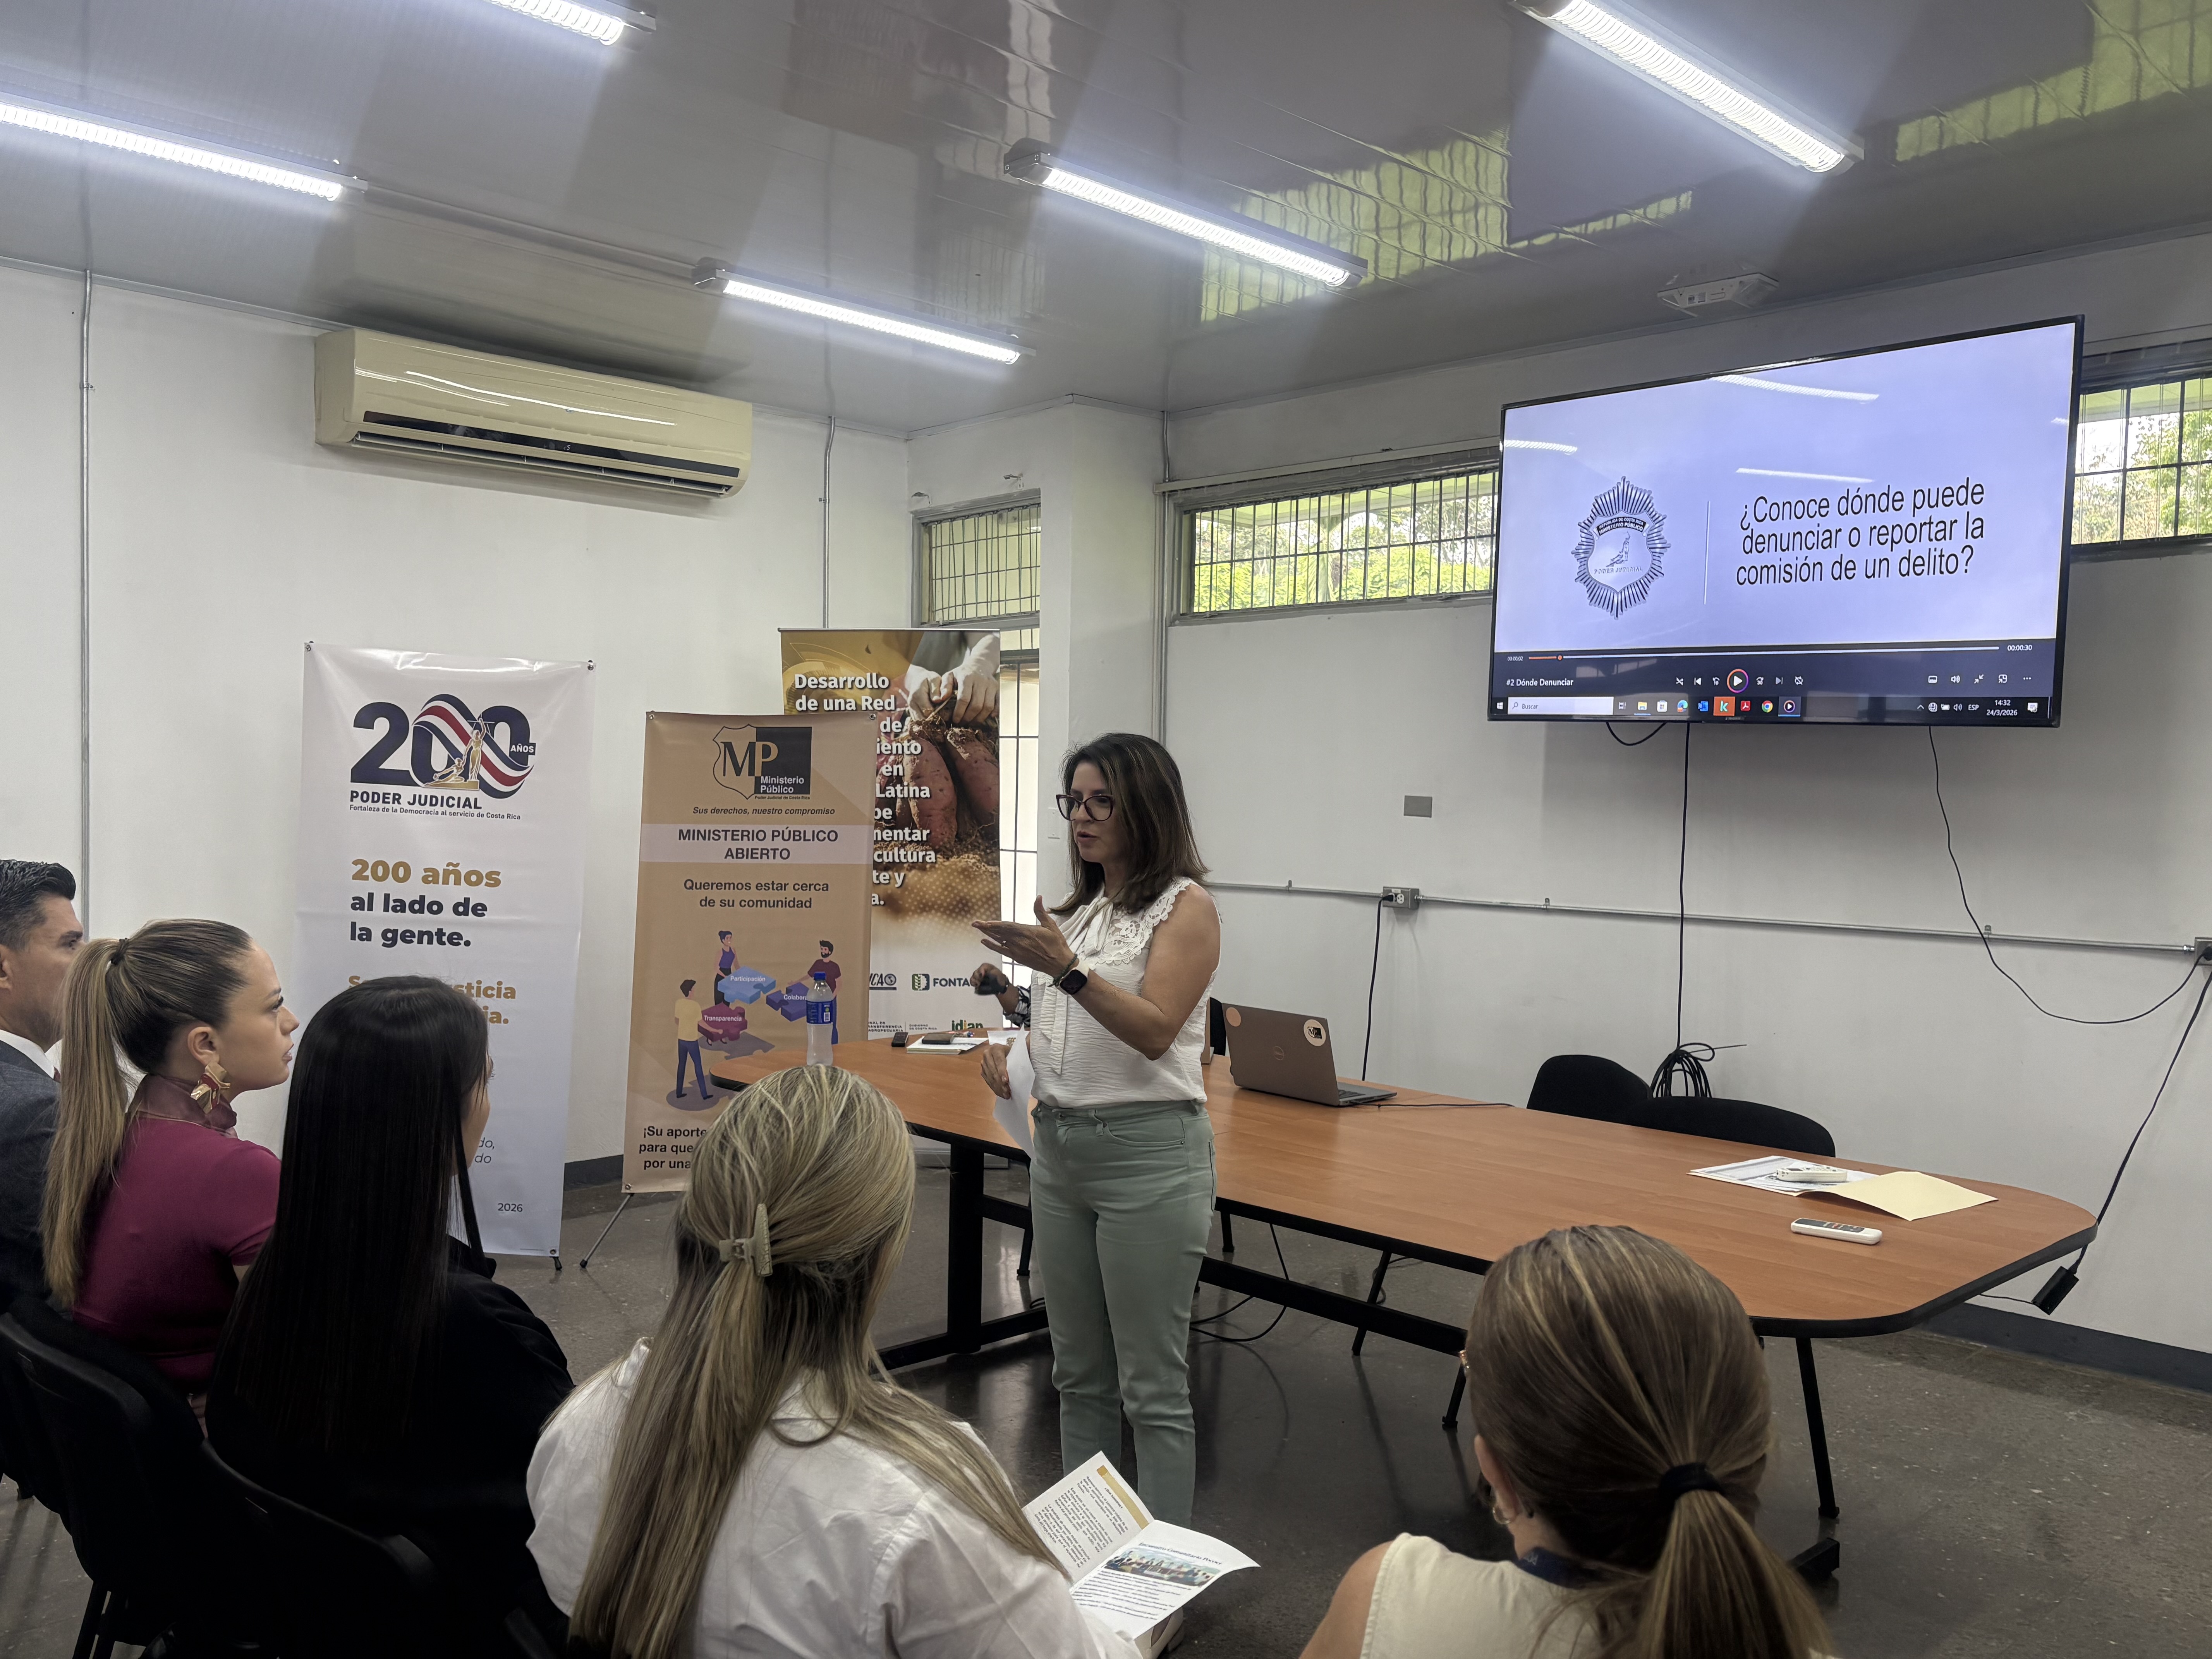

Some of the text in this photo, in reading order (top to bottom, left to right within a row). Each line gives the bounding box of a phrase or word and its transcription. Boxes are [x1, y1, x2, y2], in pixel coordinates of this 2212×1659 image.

[1740, 477, 1984, 531] ¿Conoce dónde puede
[1743, 511, 1984, 555] denunciar o reportar la
[1736, 544, 1974, 585] comisión de un delito?
[795, 673, 890, 690] Desarrollo
[795, 695, 895, 711] de una Red
[880, 717, 902, 733] de
[350, 695, 531, 788] 200
[510, 742, 534, 753] AÑOS
[876, 737, 922, 755] iento
[720, 741, 778, 777] MP
[882, 764, 903, 776] en
[761, 776, 804, 784] Ministerio
[761, 785, 794, 793] Público
[876, 781, 931, 798] Latina
[350, 790, 482, 810] PODER JUDICIAL
[400, 807, 439, 816] Democracia
[449, 809, 475, 817] servicio
[710, 807, 749, 815] derechos,
[785, 807, 835, 816] compromiso
[678, 827, 838, 842] MINISTERIO PÚBLICO
[724, 848, 790, 860] ABIERTO
[873, 847, 936, 863] cultura
[351, 859, 501, 888] 200 años
[894, 872, 905, 888] y
[684, 879, 829, 891] Queremos estar cerca
[350, 893, 488, 917] al lado de
[699, 896, 812, 908] de su comunidad
[350, 922, 471, 948] la gente.
[869, 973, 884, 986] ICA
[933, 978, 970, 987] FONTA
[453, 980, 516, 999] sticia
[644, 1126, 707, 1139] ¡Su aporte
[639, 1144, 694, 1155] para que
[644, 1160, 691, 1170] por una
[498, 1203, 523, 1212] 2026
